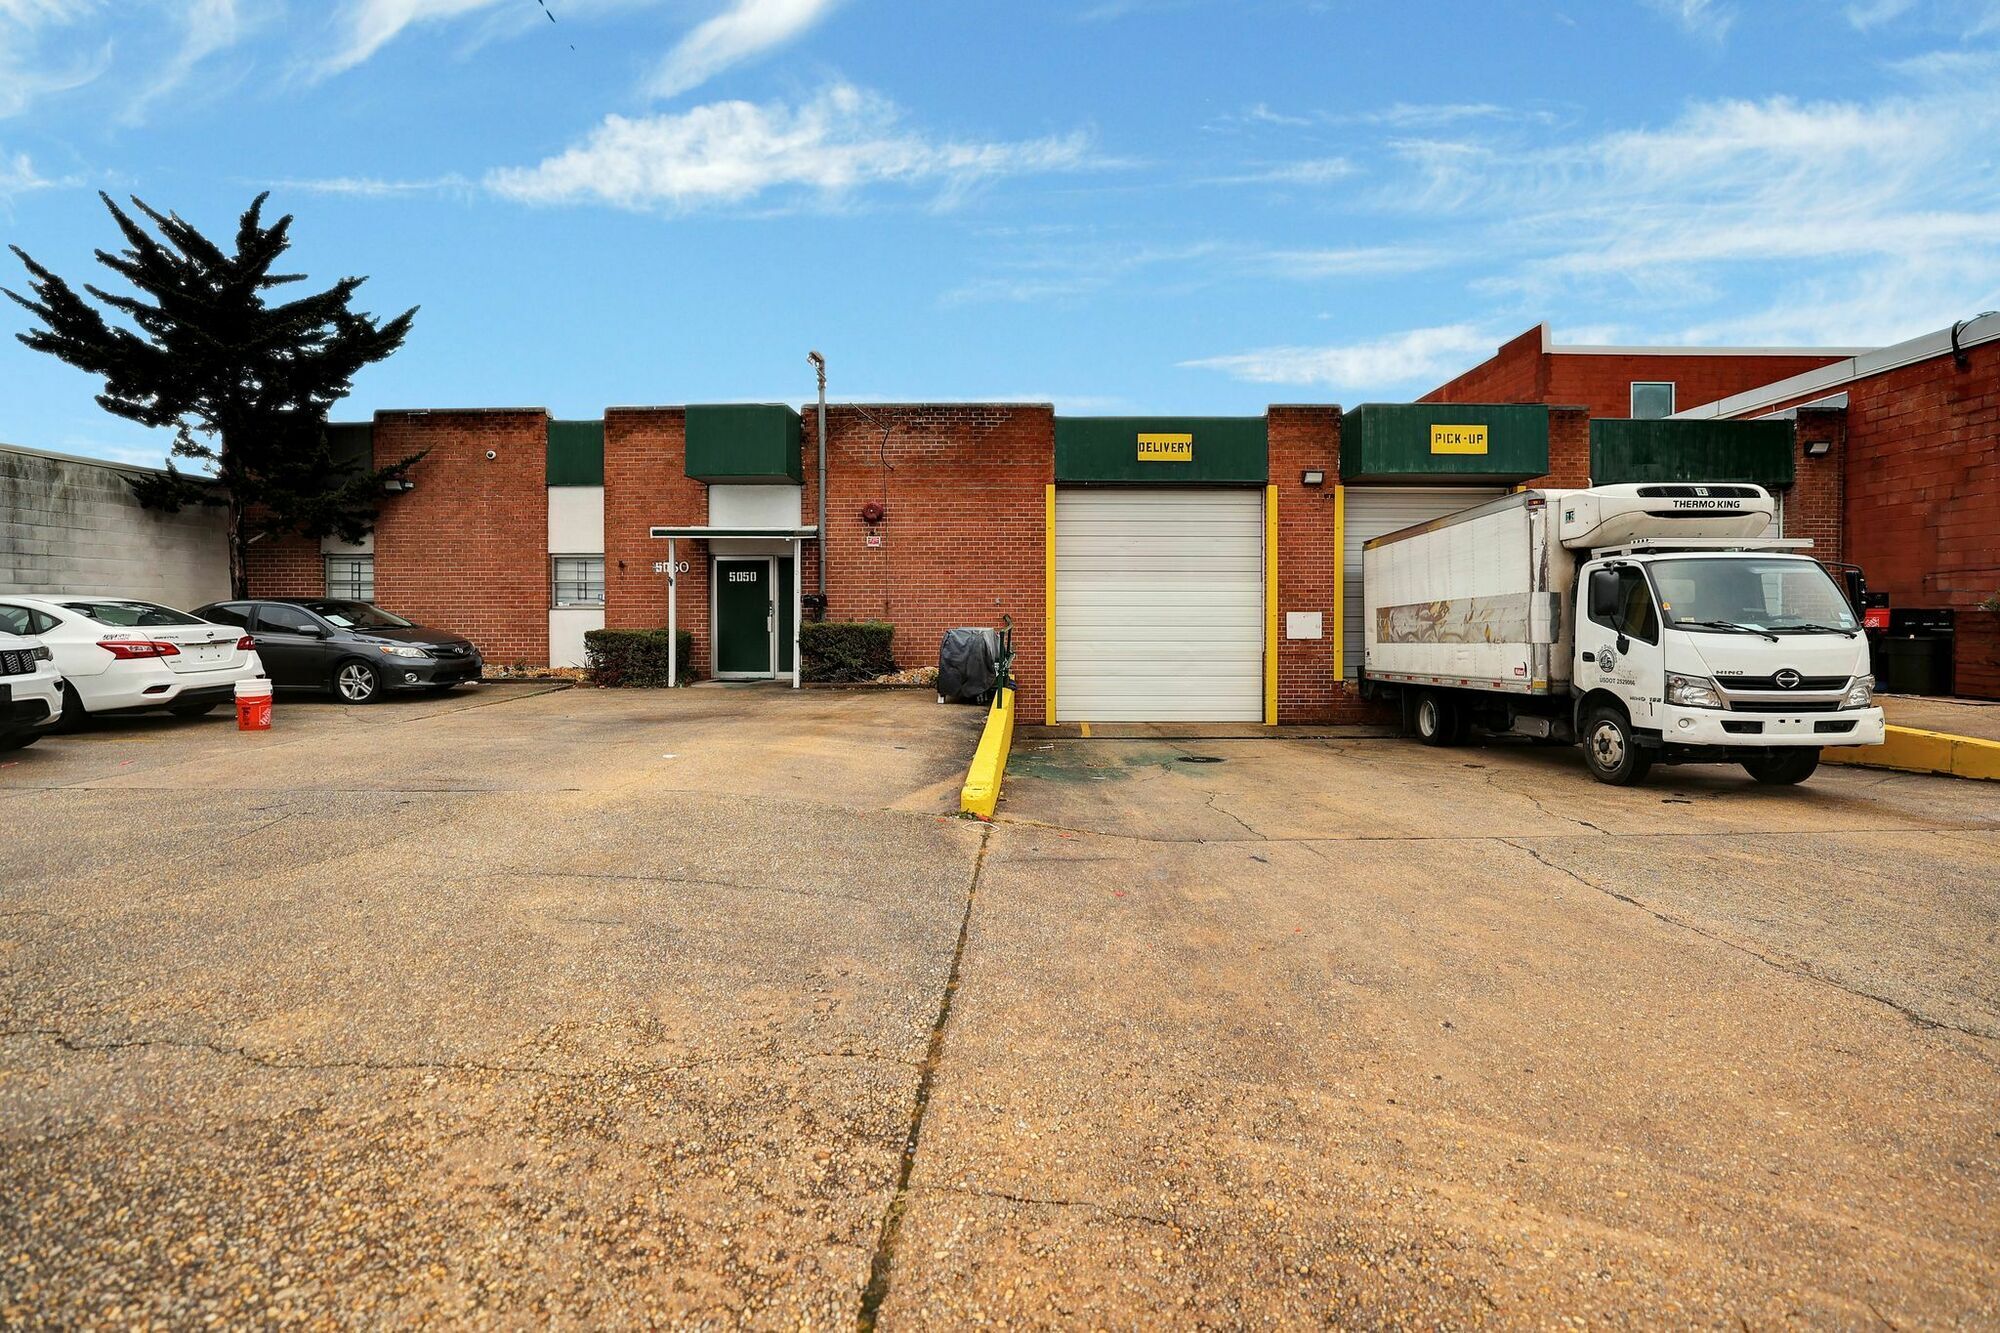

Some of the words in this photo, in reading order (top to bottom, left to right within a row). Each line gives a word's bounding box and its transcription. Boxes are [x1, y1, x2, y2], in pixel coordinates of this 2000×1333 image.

[1435, 433, 1484, 444] PICK-UP
[1138, 442, 1192, 453] DELIVERY
[1672, 500, 1715, 509] THERMO
[1717, 500, 1741, 509] KING
[728, 571, 757, 582] 5050
